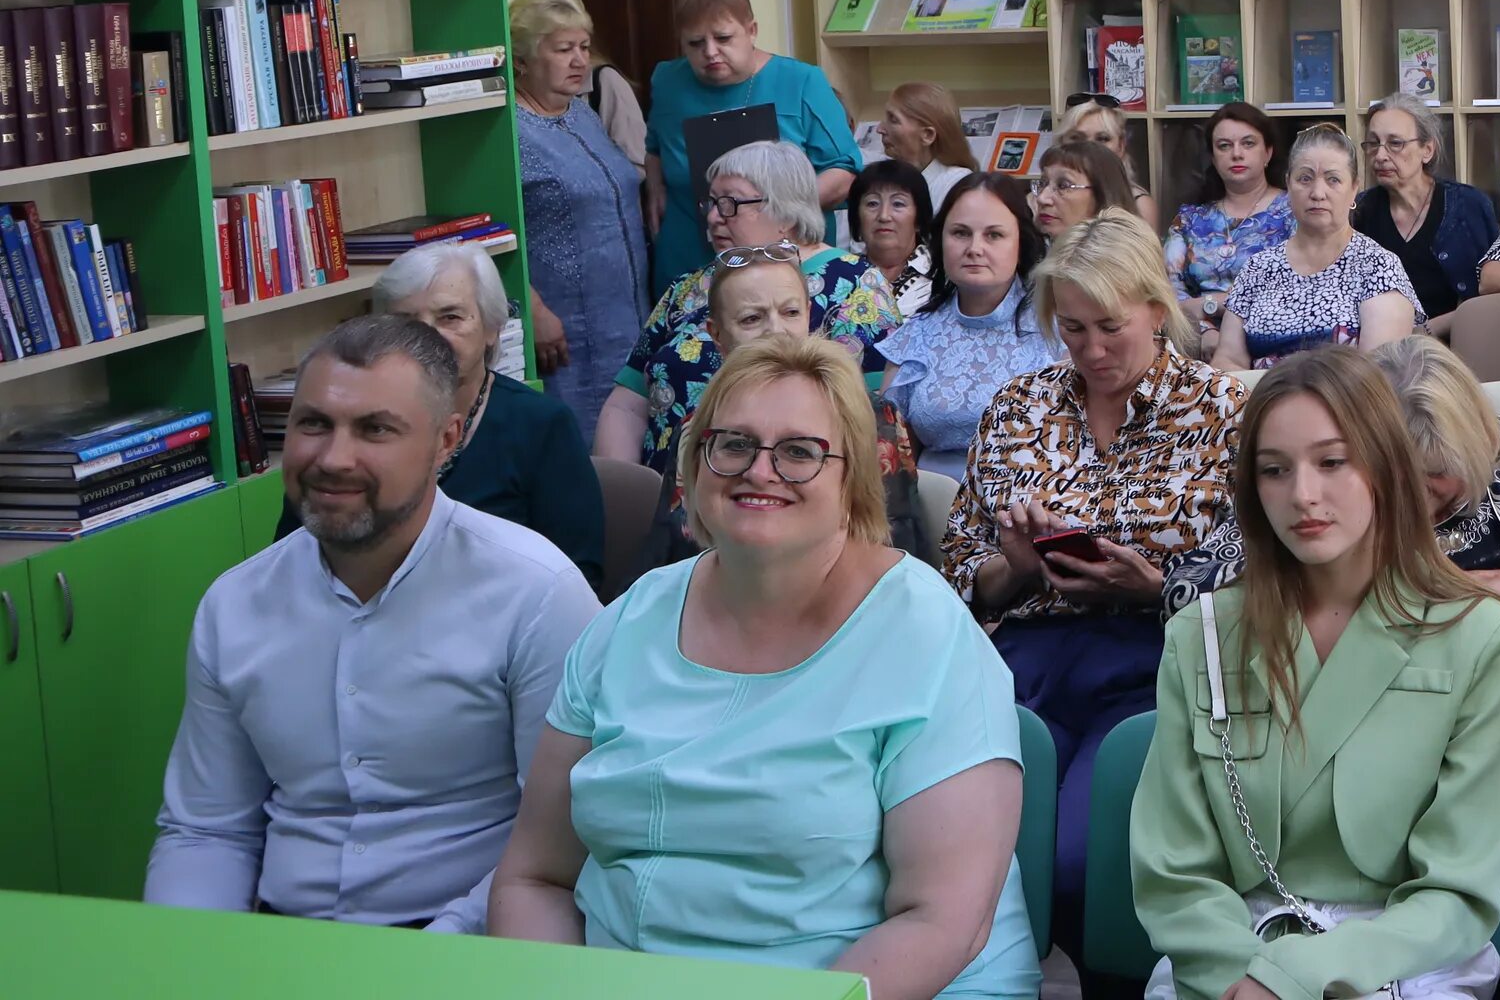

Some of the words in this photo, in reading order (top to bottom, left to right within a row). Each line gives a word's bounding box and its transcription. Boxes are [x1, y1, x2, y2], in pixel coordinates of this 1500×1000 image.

[258, 20, 270, 62] КУЛЬТУРА
[1416, 48, 1436, 64] NEXT
[24, 60, 32, 92] ВЕЛИКАЯ
[56, 55, 64, 87] ВЕЛИКАЯ
[85, 52, 93, 84] ВЕЛИКАЯ
[90, 39, 100, 95] ОТЕЧЕСТВЕННАЯ
[265, 68, 274, 106] РУССКАЯ
[331, 236, 342, 271] ТАМАДЫ
[97, 250, 113, 302] ТАТАРЫ
[140, 468, 167, 484] ЗЕМЛЯ
[170, 455, 208, 475] ЧЕЛОВЕК
[83, 480, 135, 503] ВСЕЛЕННАЯ
[1177, 521, 1197, 537] the
